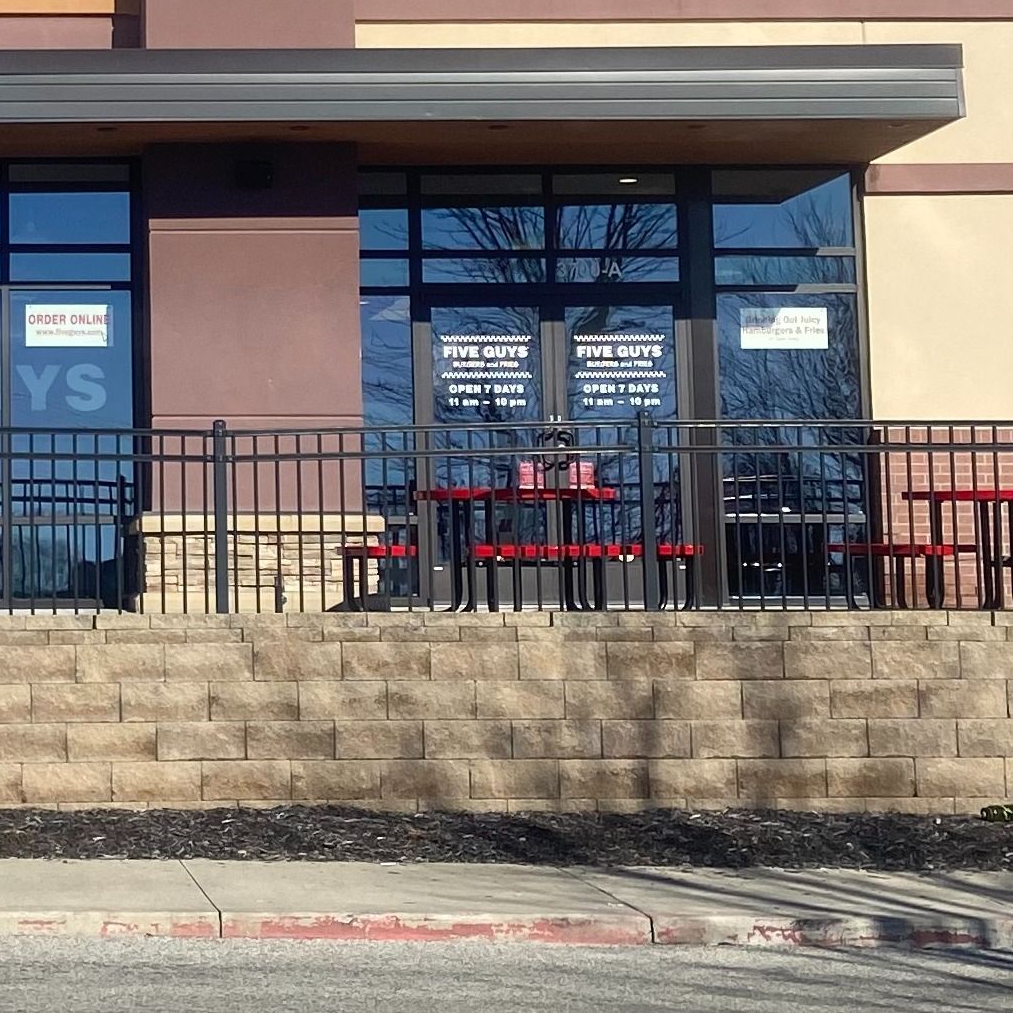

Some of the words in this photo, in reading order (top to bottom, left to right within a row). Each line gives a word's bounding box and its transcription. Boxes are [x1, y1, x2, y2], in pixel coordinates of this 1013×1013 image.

[28, 314, 67, 325] ORDER
[70, 314, 111, 325] ONLINE
[800, 315, 821, 325] Juicy
[805, 326, 825, 334] Fries
[443, 345, 480, 358] FIVE
[483, 345, 530, 358] GUYS
[576, 345, 614, 358] FIVE
[616, 344, 664, 358] GUYS
[448, 384, 482, 394] OPEN
[483, 384, 492, 394] 7
[494, 384, 525, 394] DAYS
[583, 383, 616, 394] OPEN
[617, 383, 626, 394] 7
[628, 383, 659, 394] DAYS
[448, 397, 460, 407] 11
[462, 398, 480, 406] am
[494, 397, 508, 406] 10
[509, 398, 527, 408] pm
[582, 397, 594, 406] 11
[596, 397, 614, 406] am
[629, 396, 642, 406] 10
[643, 397, 661, 407] pm
